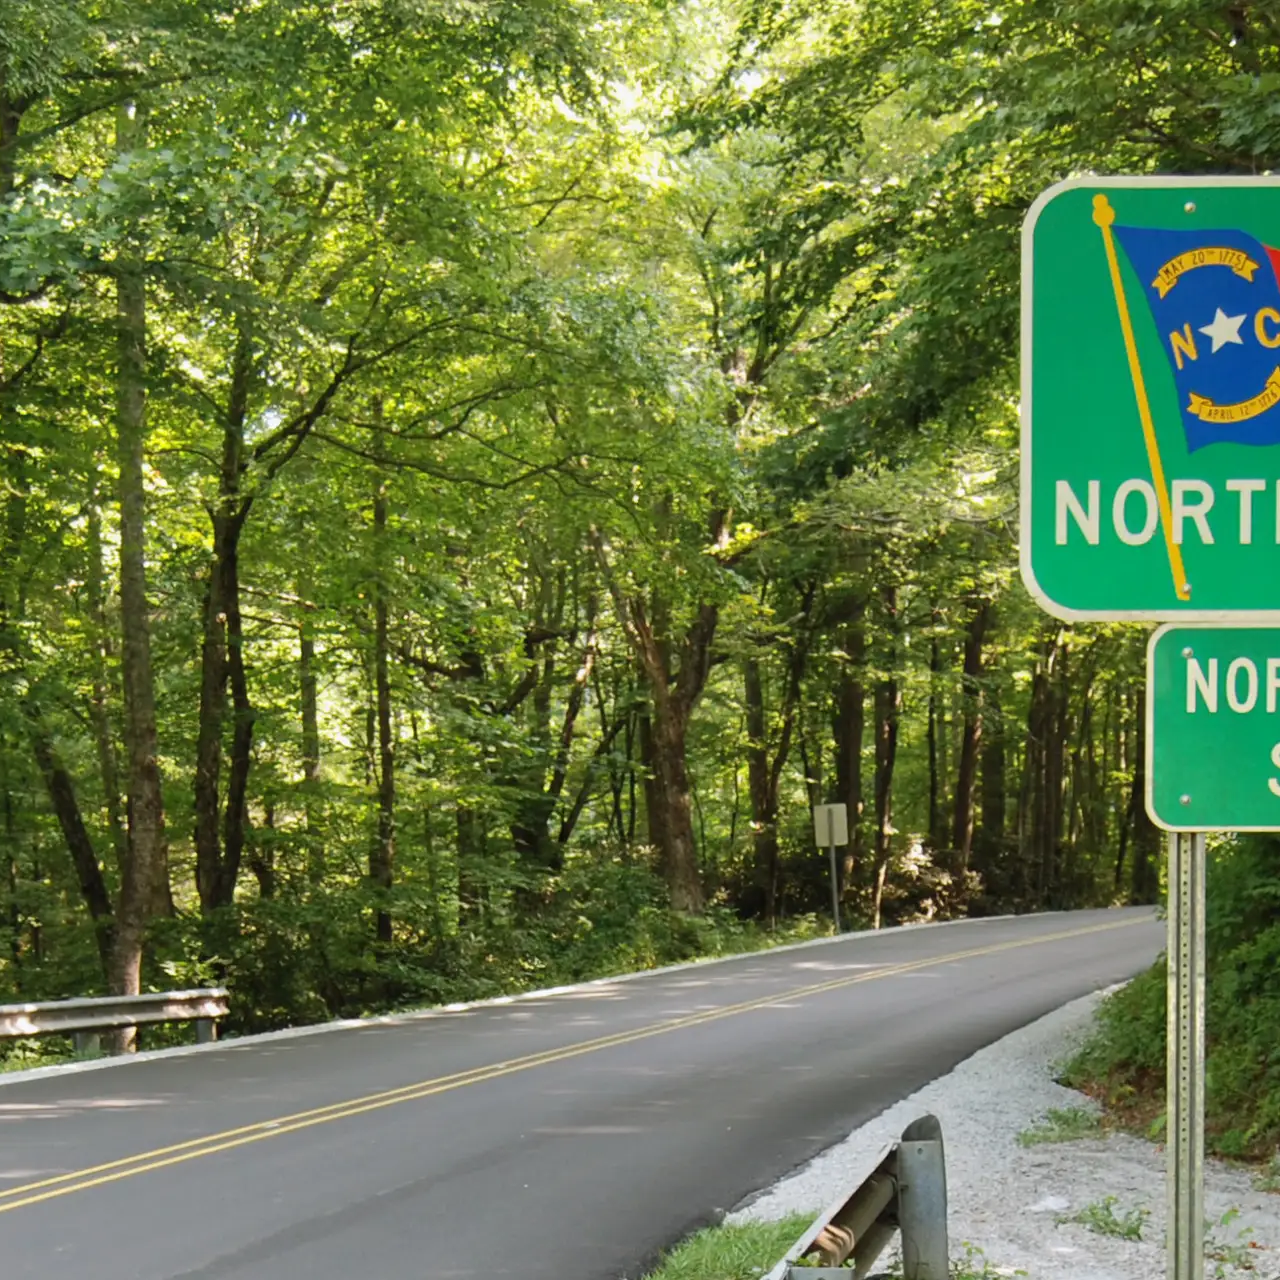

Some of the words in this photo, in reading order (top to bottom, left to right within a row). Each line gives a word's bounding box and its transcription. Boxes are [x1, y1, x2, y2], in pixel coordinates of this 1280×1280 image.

[1162, 258, 1185, 279] MAY
[1220, 250, 1242, 268] 1775
[1169, 322, 1198, 371] N
[1207, 408, 1235, 420] APRIL
